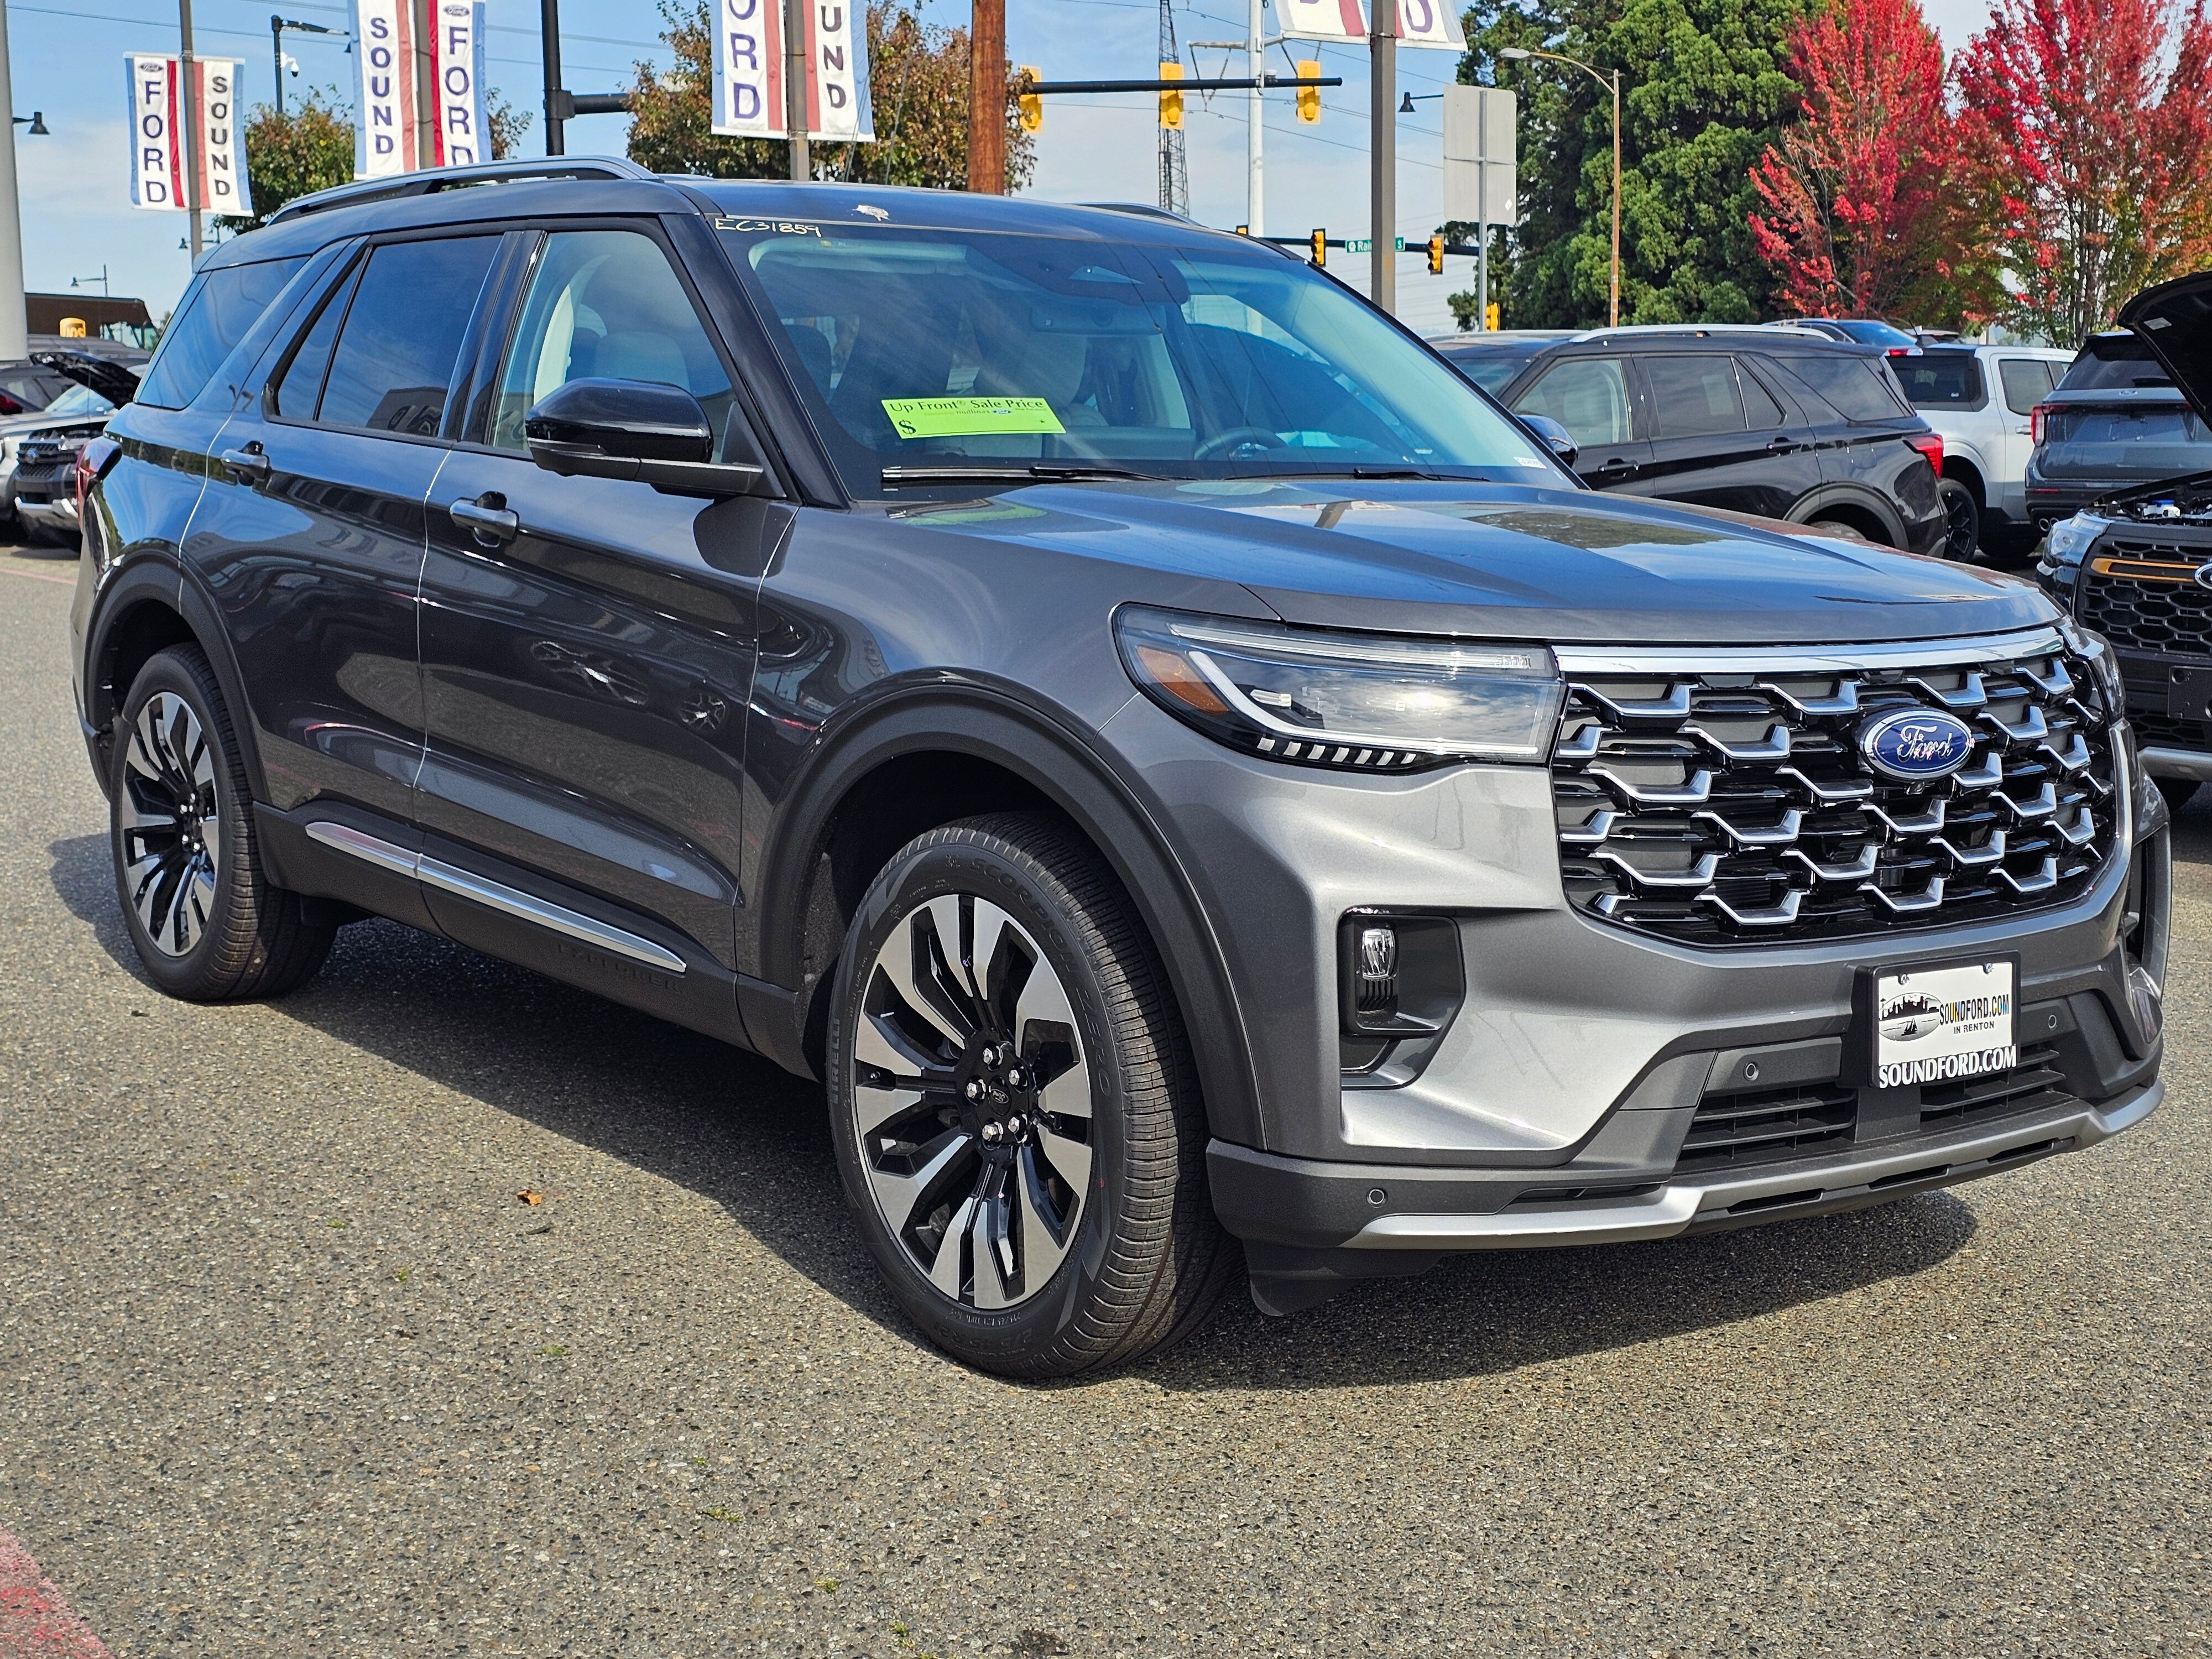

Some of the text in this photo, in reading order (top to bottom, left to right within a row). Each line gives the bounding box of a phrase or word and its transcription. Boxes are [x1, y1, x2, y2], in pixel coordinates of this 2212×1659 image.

[371, 17, 394, 154] SOUND
[445, 26, 473, 165] FORD
[143, 81, 166, 202] FORD
[211, 76, 230, 195] SOUND
[714, 218, 821, 238] EC31859
[890, 403, 913, 413] Up
[970, 399, 1001, 409] Sale
[1005, 399, 1044, 408] Price
[899, 419, 916, 436] $
[1897, 725, 1954, 761] Ford
[970, 858, 1112, 1097] SCORPION ZERO
[1939, 994, 2009, 1025] SOUNDFORD.COM
[1953, 1021, 1995, 1034] IN RENTON
[831, 1018, 840, 1104] PIRELLI
[1879, 1045, 2017, 1089] SOUNDFORD.COM
